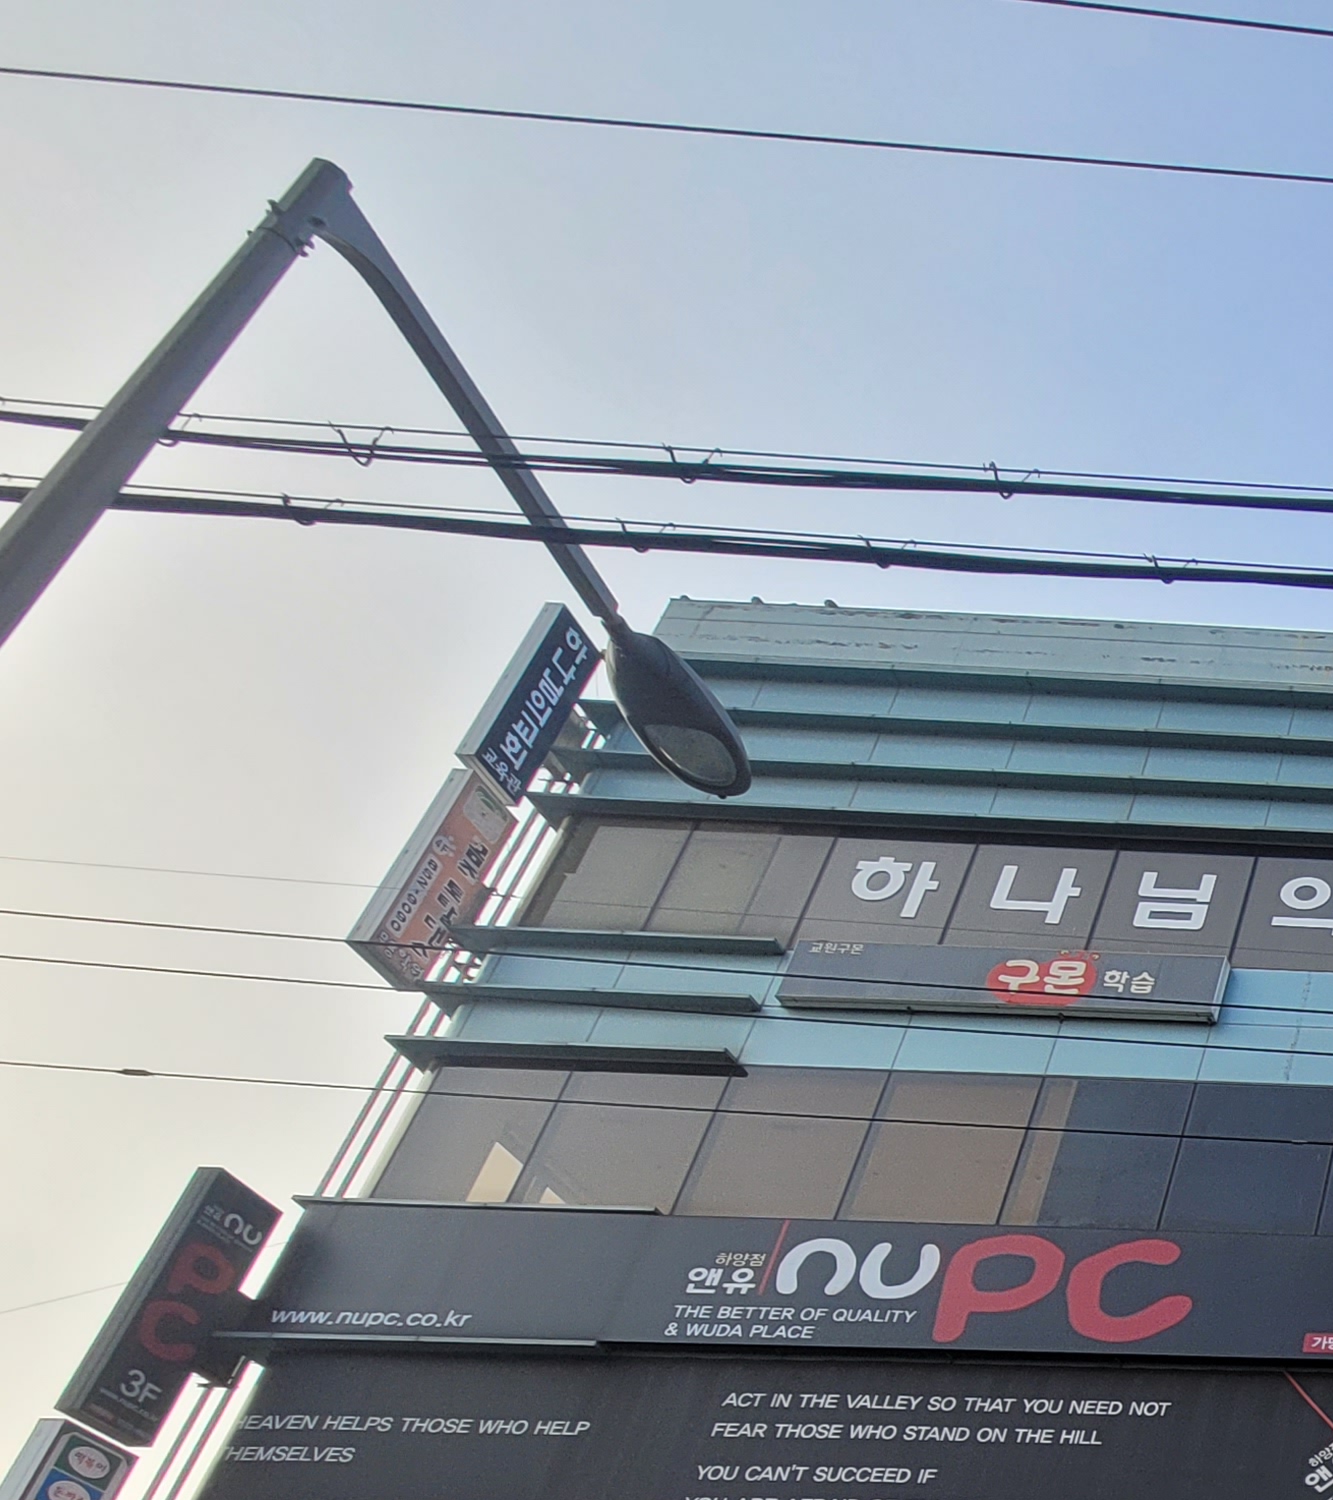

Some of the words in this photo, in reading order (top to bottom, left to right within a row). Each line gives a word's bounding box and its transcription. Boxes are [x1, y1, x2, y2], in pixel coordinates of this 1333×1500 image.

[809, 941, 864, 955] 교원구몬
[997, 958, 1086, 996] 구몬
[1103, 969, 1156, 994] 학습
[715, 1251, 767, 1269] 하양점
[686, 1267, 757, 1295] 앤유
[270, 1307, 473, 1330] www.nupc.co.kr
[674, 1305, 712, 1319] THE
[716, 1305, 796, 1321] BETTER
[800, 1308, 828, 1322] OF
[832, 1309, 917, 1325] QUALITY
[664, 1322, 678, 1338] &
[684, 1323, 745, 1339] WUDA
[748, 1325, 815, 1340] PLACE
[119, 1368, 163, 1403] 3F
[722, 1392, 767, 1408] ACT
[770, 1392, 792, 1408] IN
[798, 1393, 839, 1409] THE
[846, 1394, 923, 1411] VALLEY
[927, 1396, 957, 1412] SO
[964, 1397, 1016, 1414] THAT
[1022, 1399, 1063, 1415] YOU
[1068, 1400, 1123, 1416] NEED
[1128, 1401, 1171, 1417] NOT
[323, 1415, 394, 1433] HELPS
[400, 1416, 474, 1434] THOSE
[478, 1418, 528, 1436] WHO
[533, 1419, 591, 1437] HELP
[710, 1423, 767, 1439] FEAR
[775, 1424, 843, 1441] THOSE
[848, 1425, 897, 1441] WHO
[902, 1426, 971, 1443] STAND
[976, 1427, 1007, 1444] ON
[1014, 1428, 1055, 1445] THE
[1058, 1429, 1103, 1446] HILL
[225, 1446, 356, 1462] HEMSELVES
[696, 1464, 740, 1482] YOU
[744, 1464, 808, 1483] CAN'T
[812, 1466, 911, 1484] SUCCEED
[917, 1468, 938, 1485] IF
